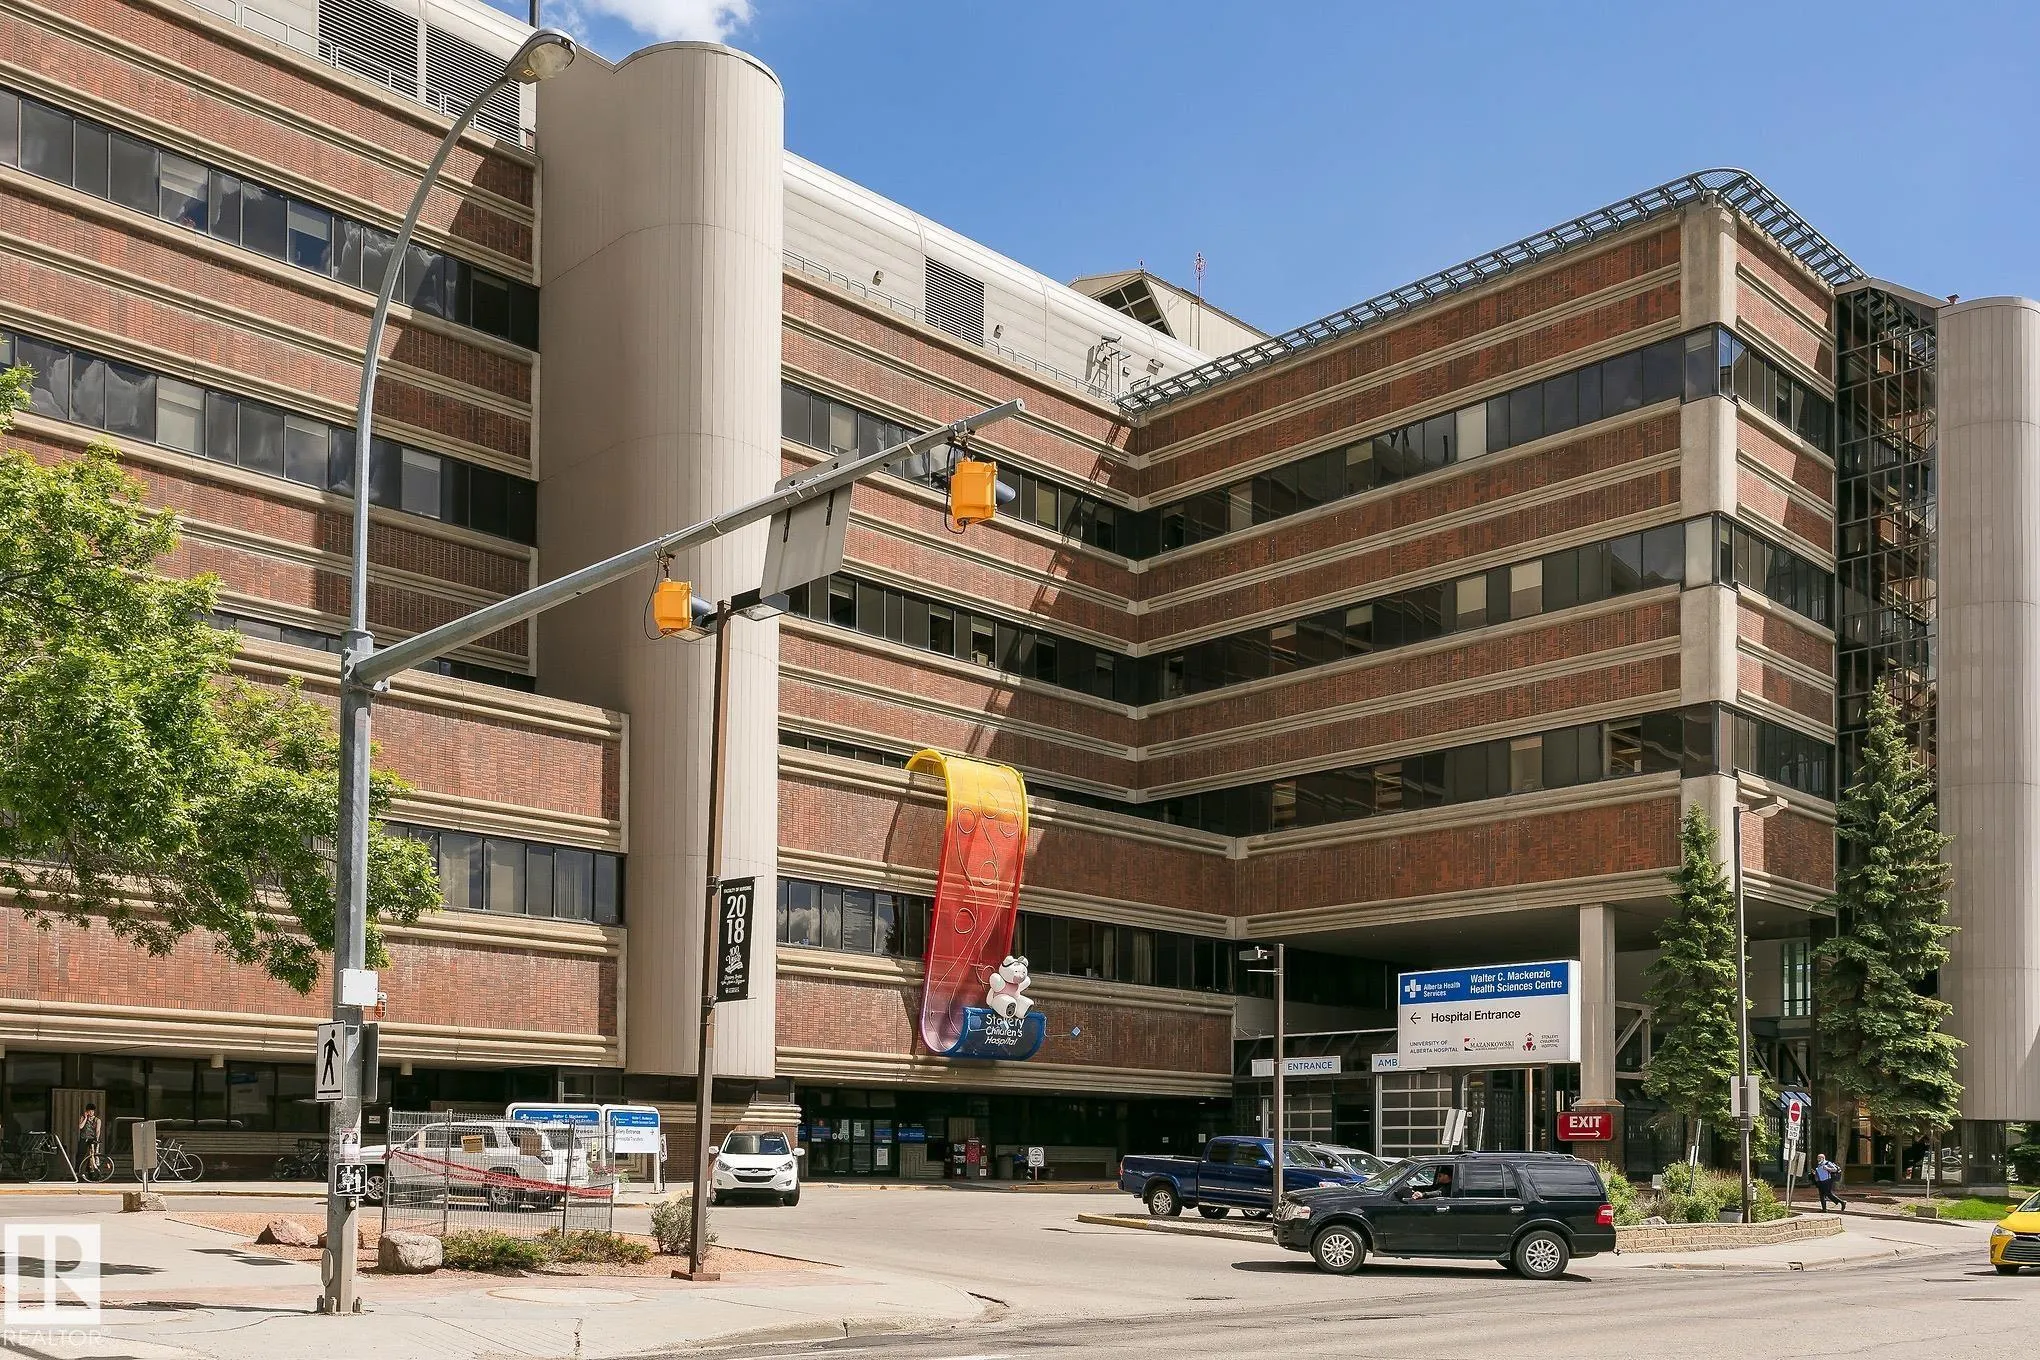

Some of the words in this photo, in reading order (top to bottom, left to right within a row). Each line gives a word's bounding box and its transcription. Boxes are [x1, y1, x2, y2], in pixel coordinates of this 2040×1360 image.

[726, 893, 747, 919] 20
[726, 917, 745, 944] 18
[1470, 973, 1496, 984] Walter
[1497, 972, 1506, 982] C.
[1507, 969, 1551, 981] Mackenzie
[1423, 982, 1443, 991] Alberta
[1443, 981, 1461, 989] Health
[1470, 983, 1495, 995] Health
[1497, 981, 1533, 993] Sciences
[1535, 979, 1563, 990] Centre
[1423, 990, 1447, 998] Services
[985, 1013, 1025, 1029] Stoery
[1431, 1011, 1472, 1024] Hospital
[1474, 1009, 1521, 1021] Entrance
[984, 1036, 1018, 1046] Hospital
[1470, 1040, 1515, 1048] MAZANKOWSKI
[1287, 1061, 1333, 1071] ENTRANCE
[1569, 1115, 1602, 1128] EXIT
